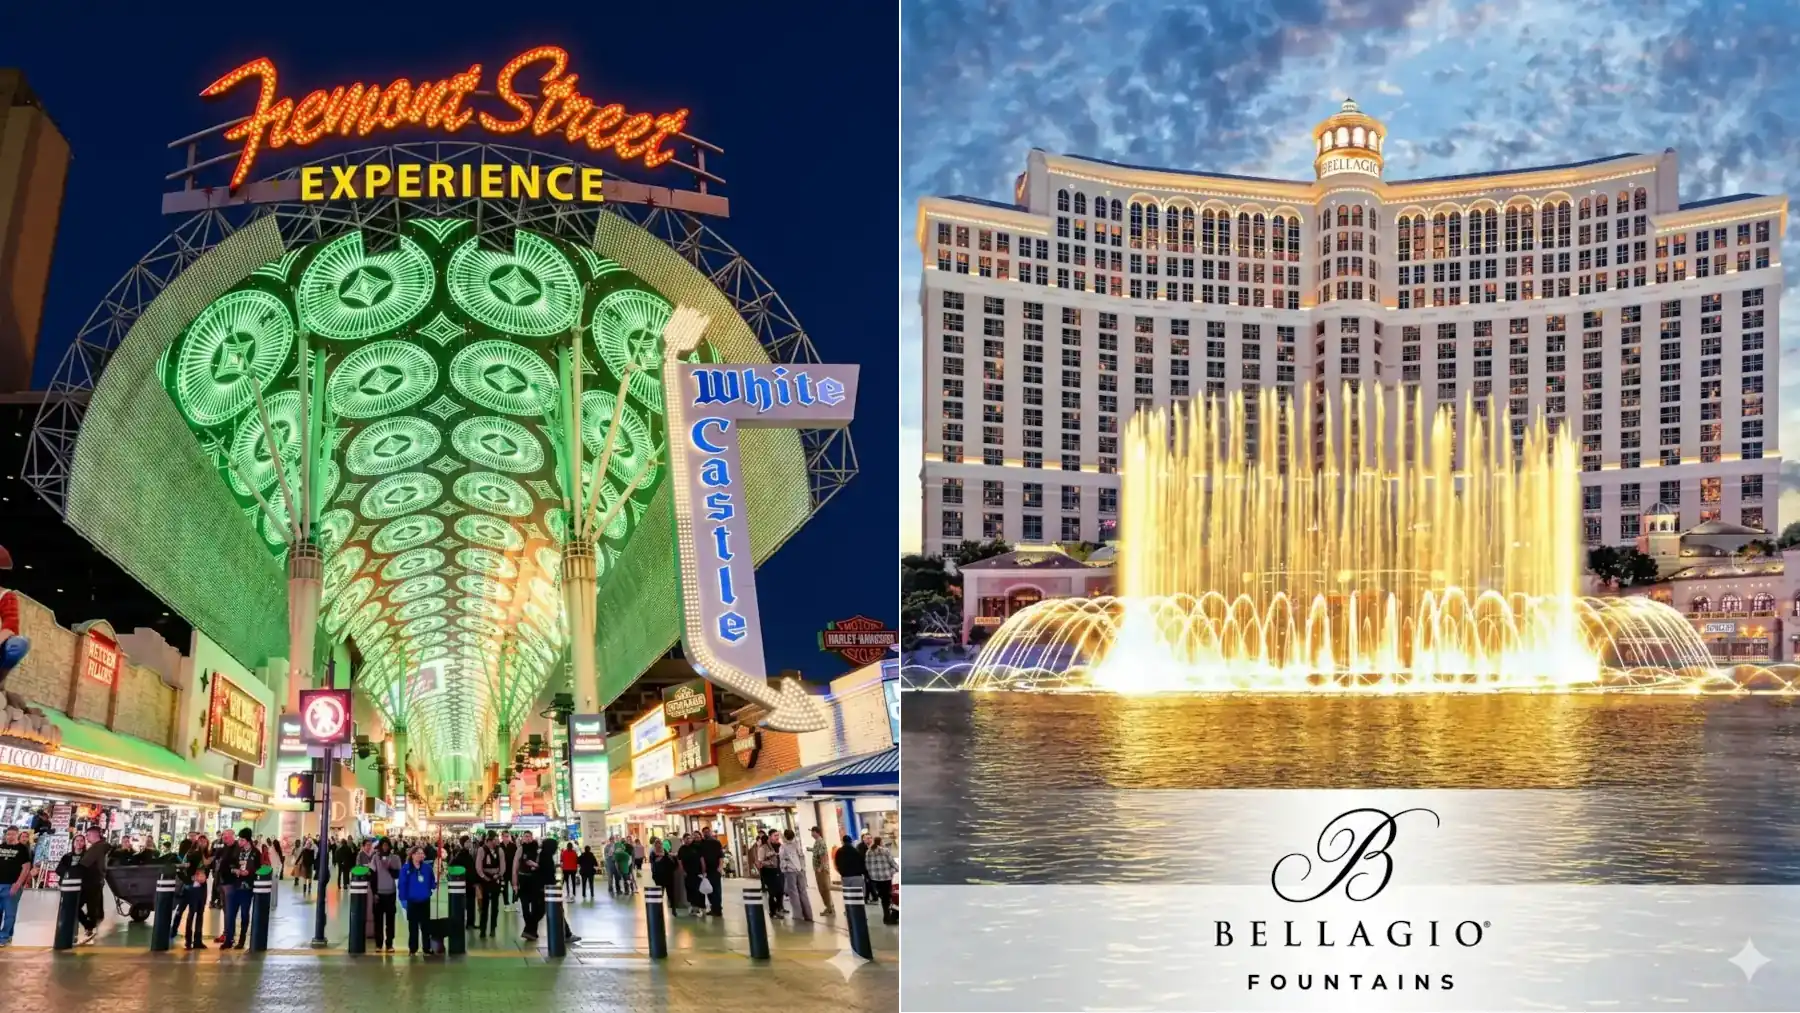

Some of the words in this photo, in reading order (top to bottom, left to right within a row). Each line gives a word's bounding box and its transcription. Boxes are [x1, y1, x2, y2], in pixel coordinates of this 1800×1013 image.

[199, 57, 483, 190] Fremont
[479, 45, 690, 168] Street
[300, 163, 605, 202] EXPERIENCE
[690, 366, 846, 412] White
[690, 416, 748, 643] Castle
